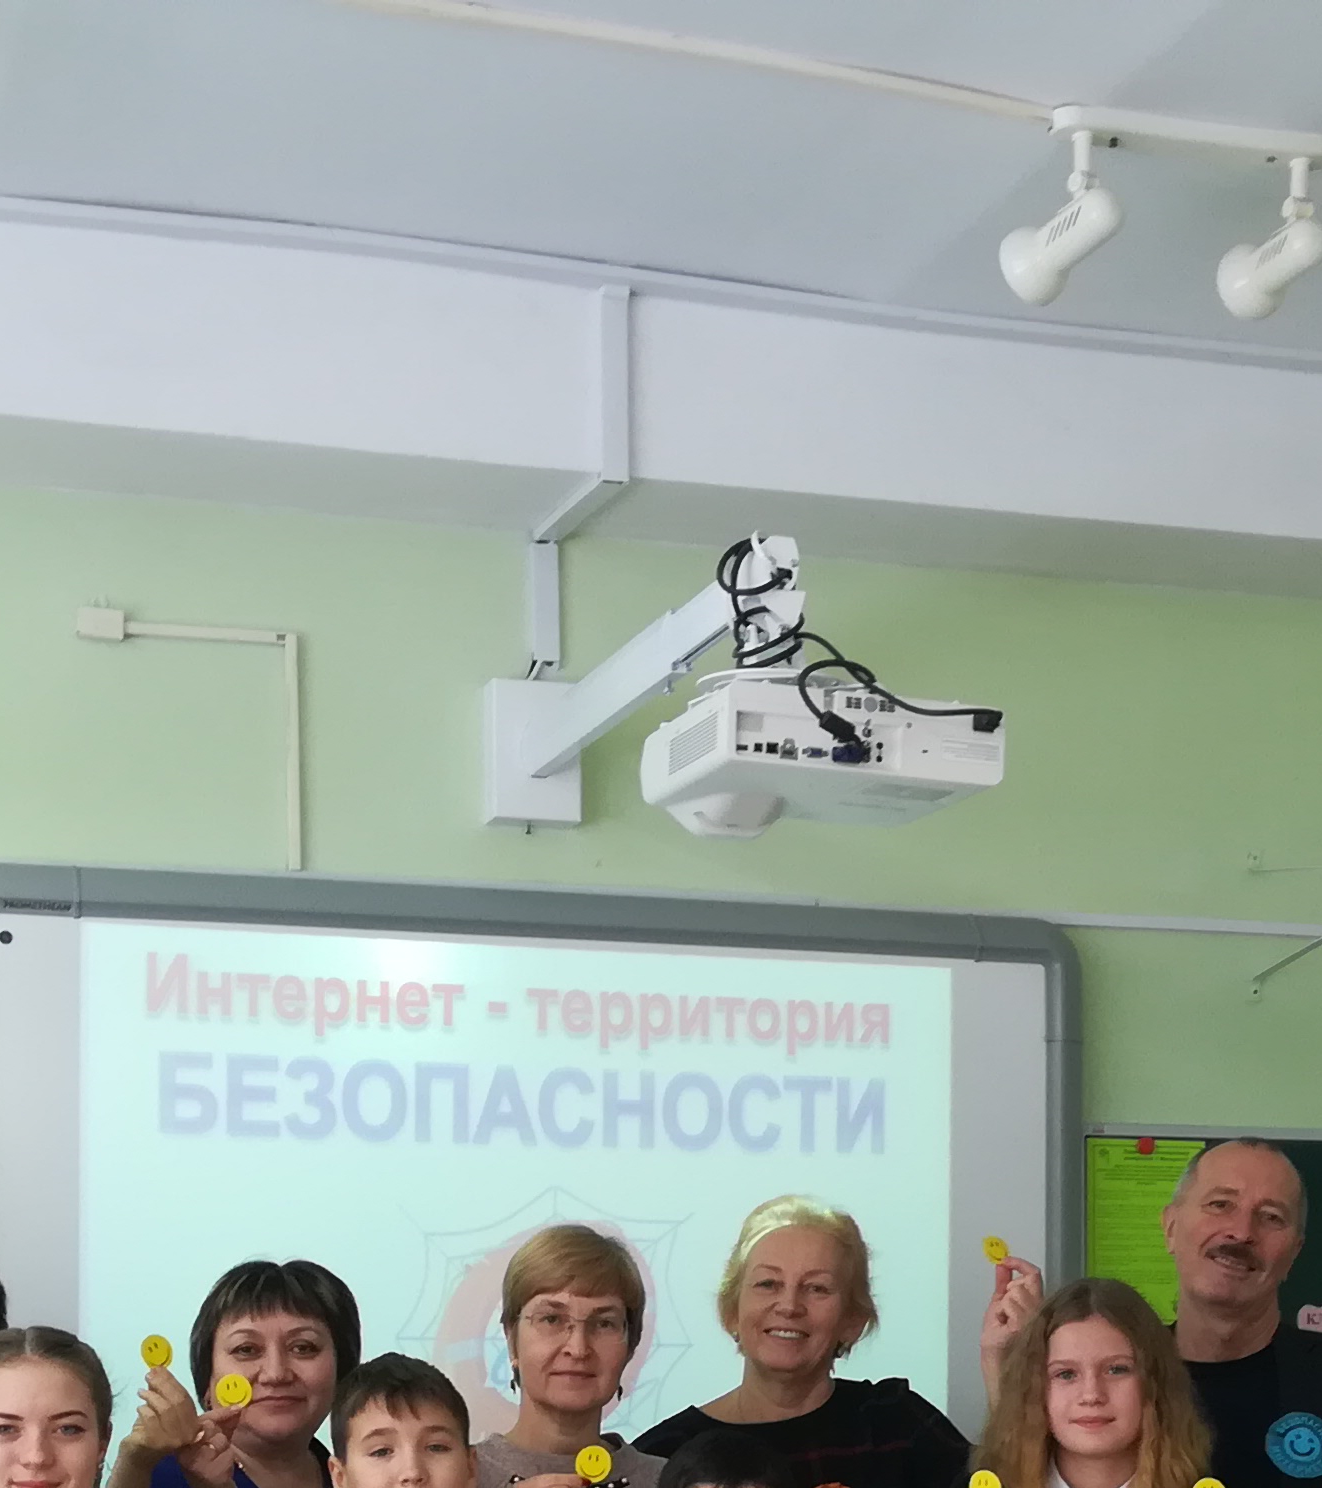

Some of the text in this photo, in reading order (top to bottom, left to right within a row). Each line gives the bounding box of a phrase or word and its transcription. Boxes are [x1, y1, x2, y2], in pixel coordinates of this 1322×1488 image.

[145, 951, 465, 1037] Интернет
[526, 988, 890, 1056] территория
[158, 1050, 886, 1155] БЕЗОПАСНОСТИ
